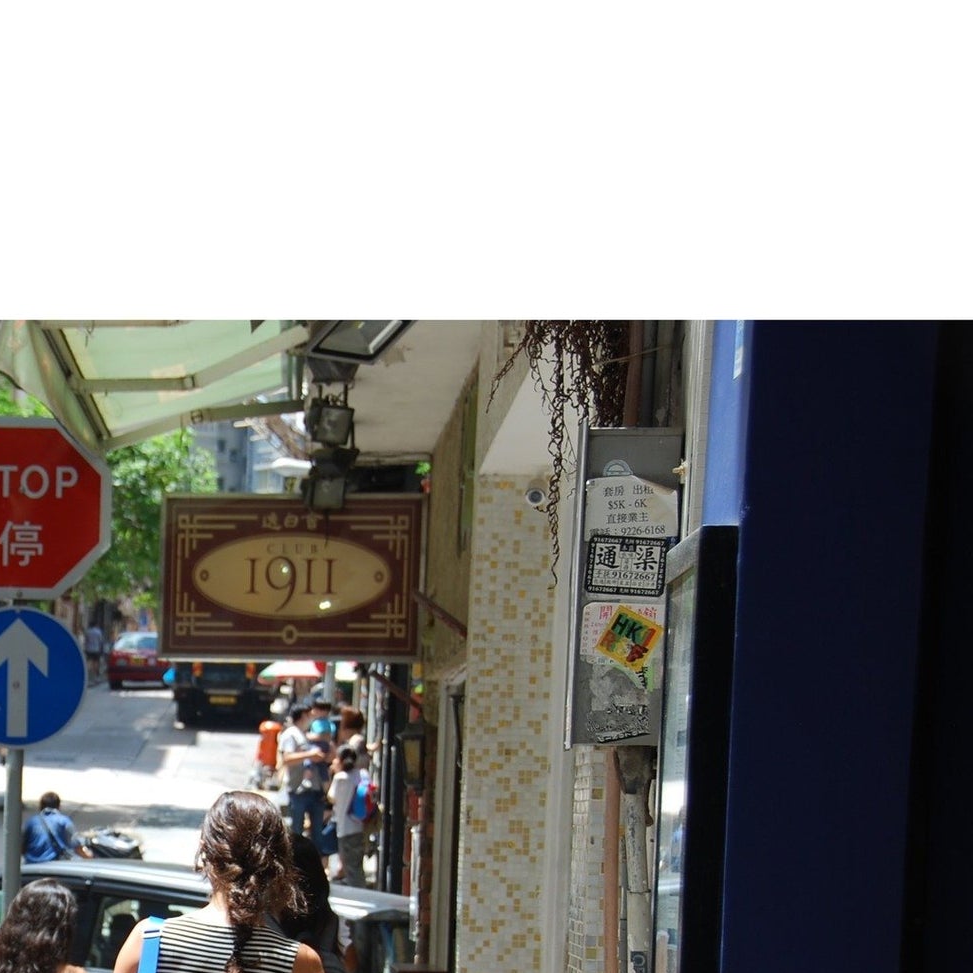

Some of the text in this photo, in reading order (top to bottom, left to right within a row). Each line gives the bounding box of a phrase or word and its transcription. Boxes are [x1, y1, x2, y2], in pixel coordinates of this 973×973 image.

[603, 485, 625, 498] 套房
[607, 500, 625, 510] $5K
[634, 498, 647, 508] 6K
[606, 511, 649, 525] 直接業主
[620, 525, 666, 536] 9226-6168
[266, 543, 318, 554] CLUB
[595, 545, 620, 569] 通
[633, 546, 658, 572] 渠
[611, 571, 656, 581] 91672667
[244, 555, 337, 613] 1911
